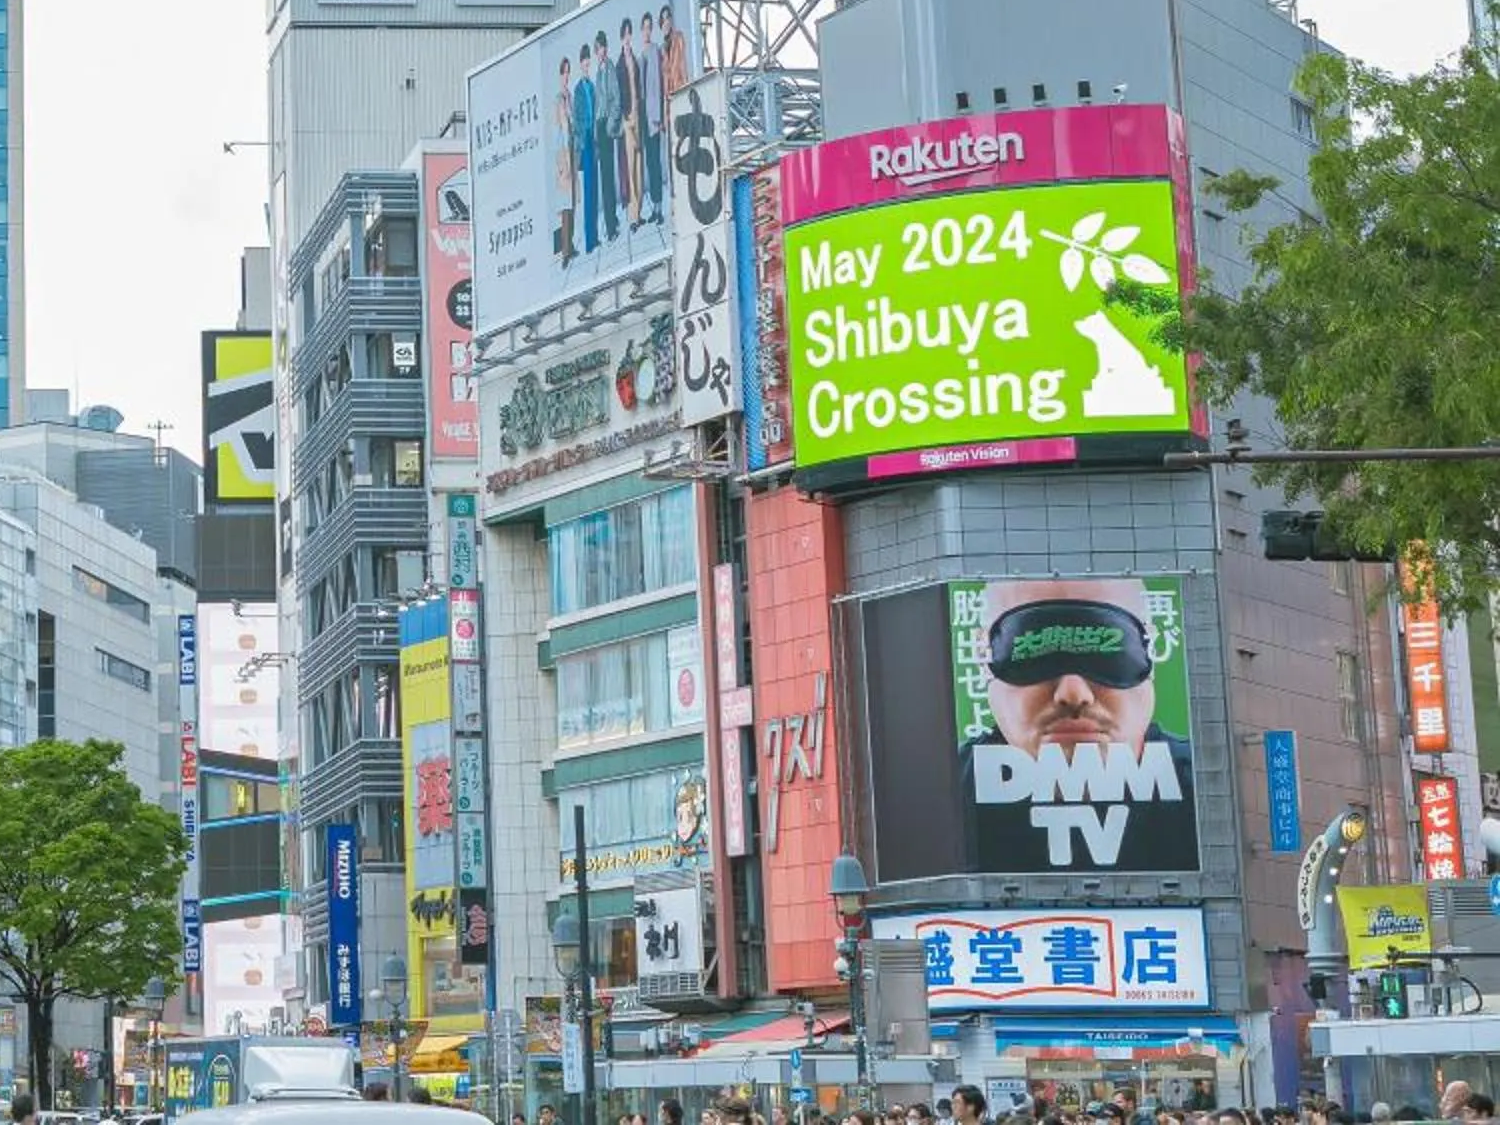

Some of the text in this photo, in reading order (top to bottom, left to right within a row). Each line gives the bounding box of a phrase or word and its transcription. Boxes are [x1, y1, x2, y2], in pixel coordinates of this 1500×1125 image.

[870, 131, 1025, 181] Rakuten
[674, 86, 732, 407] もんじゃ
[800, 210, 1032, 294] May 2024
[804, 296, 1030, 368] Shibuya
[807, 358, 1068, 438] Crossing
[920, 445, 1009, 467] Rakuten Vision
[1140, 590, 1179, 662] 再び
[179, 637, 195, 685] LABI
[953, 589, 993, 738] 脱出せよ
[1407, 621, 1445, 736] 三千里
[181, 737, 196, 787] LABI
[972, 742, 1183, 804] DMM
[1030, 804, 1130, 866] TV
[338, 839, 351, 899] MIZUHO
[185, 922, 199, 971] LABI
[896, 927, 1178, 986] 盛堂書店
